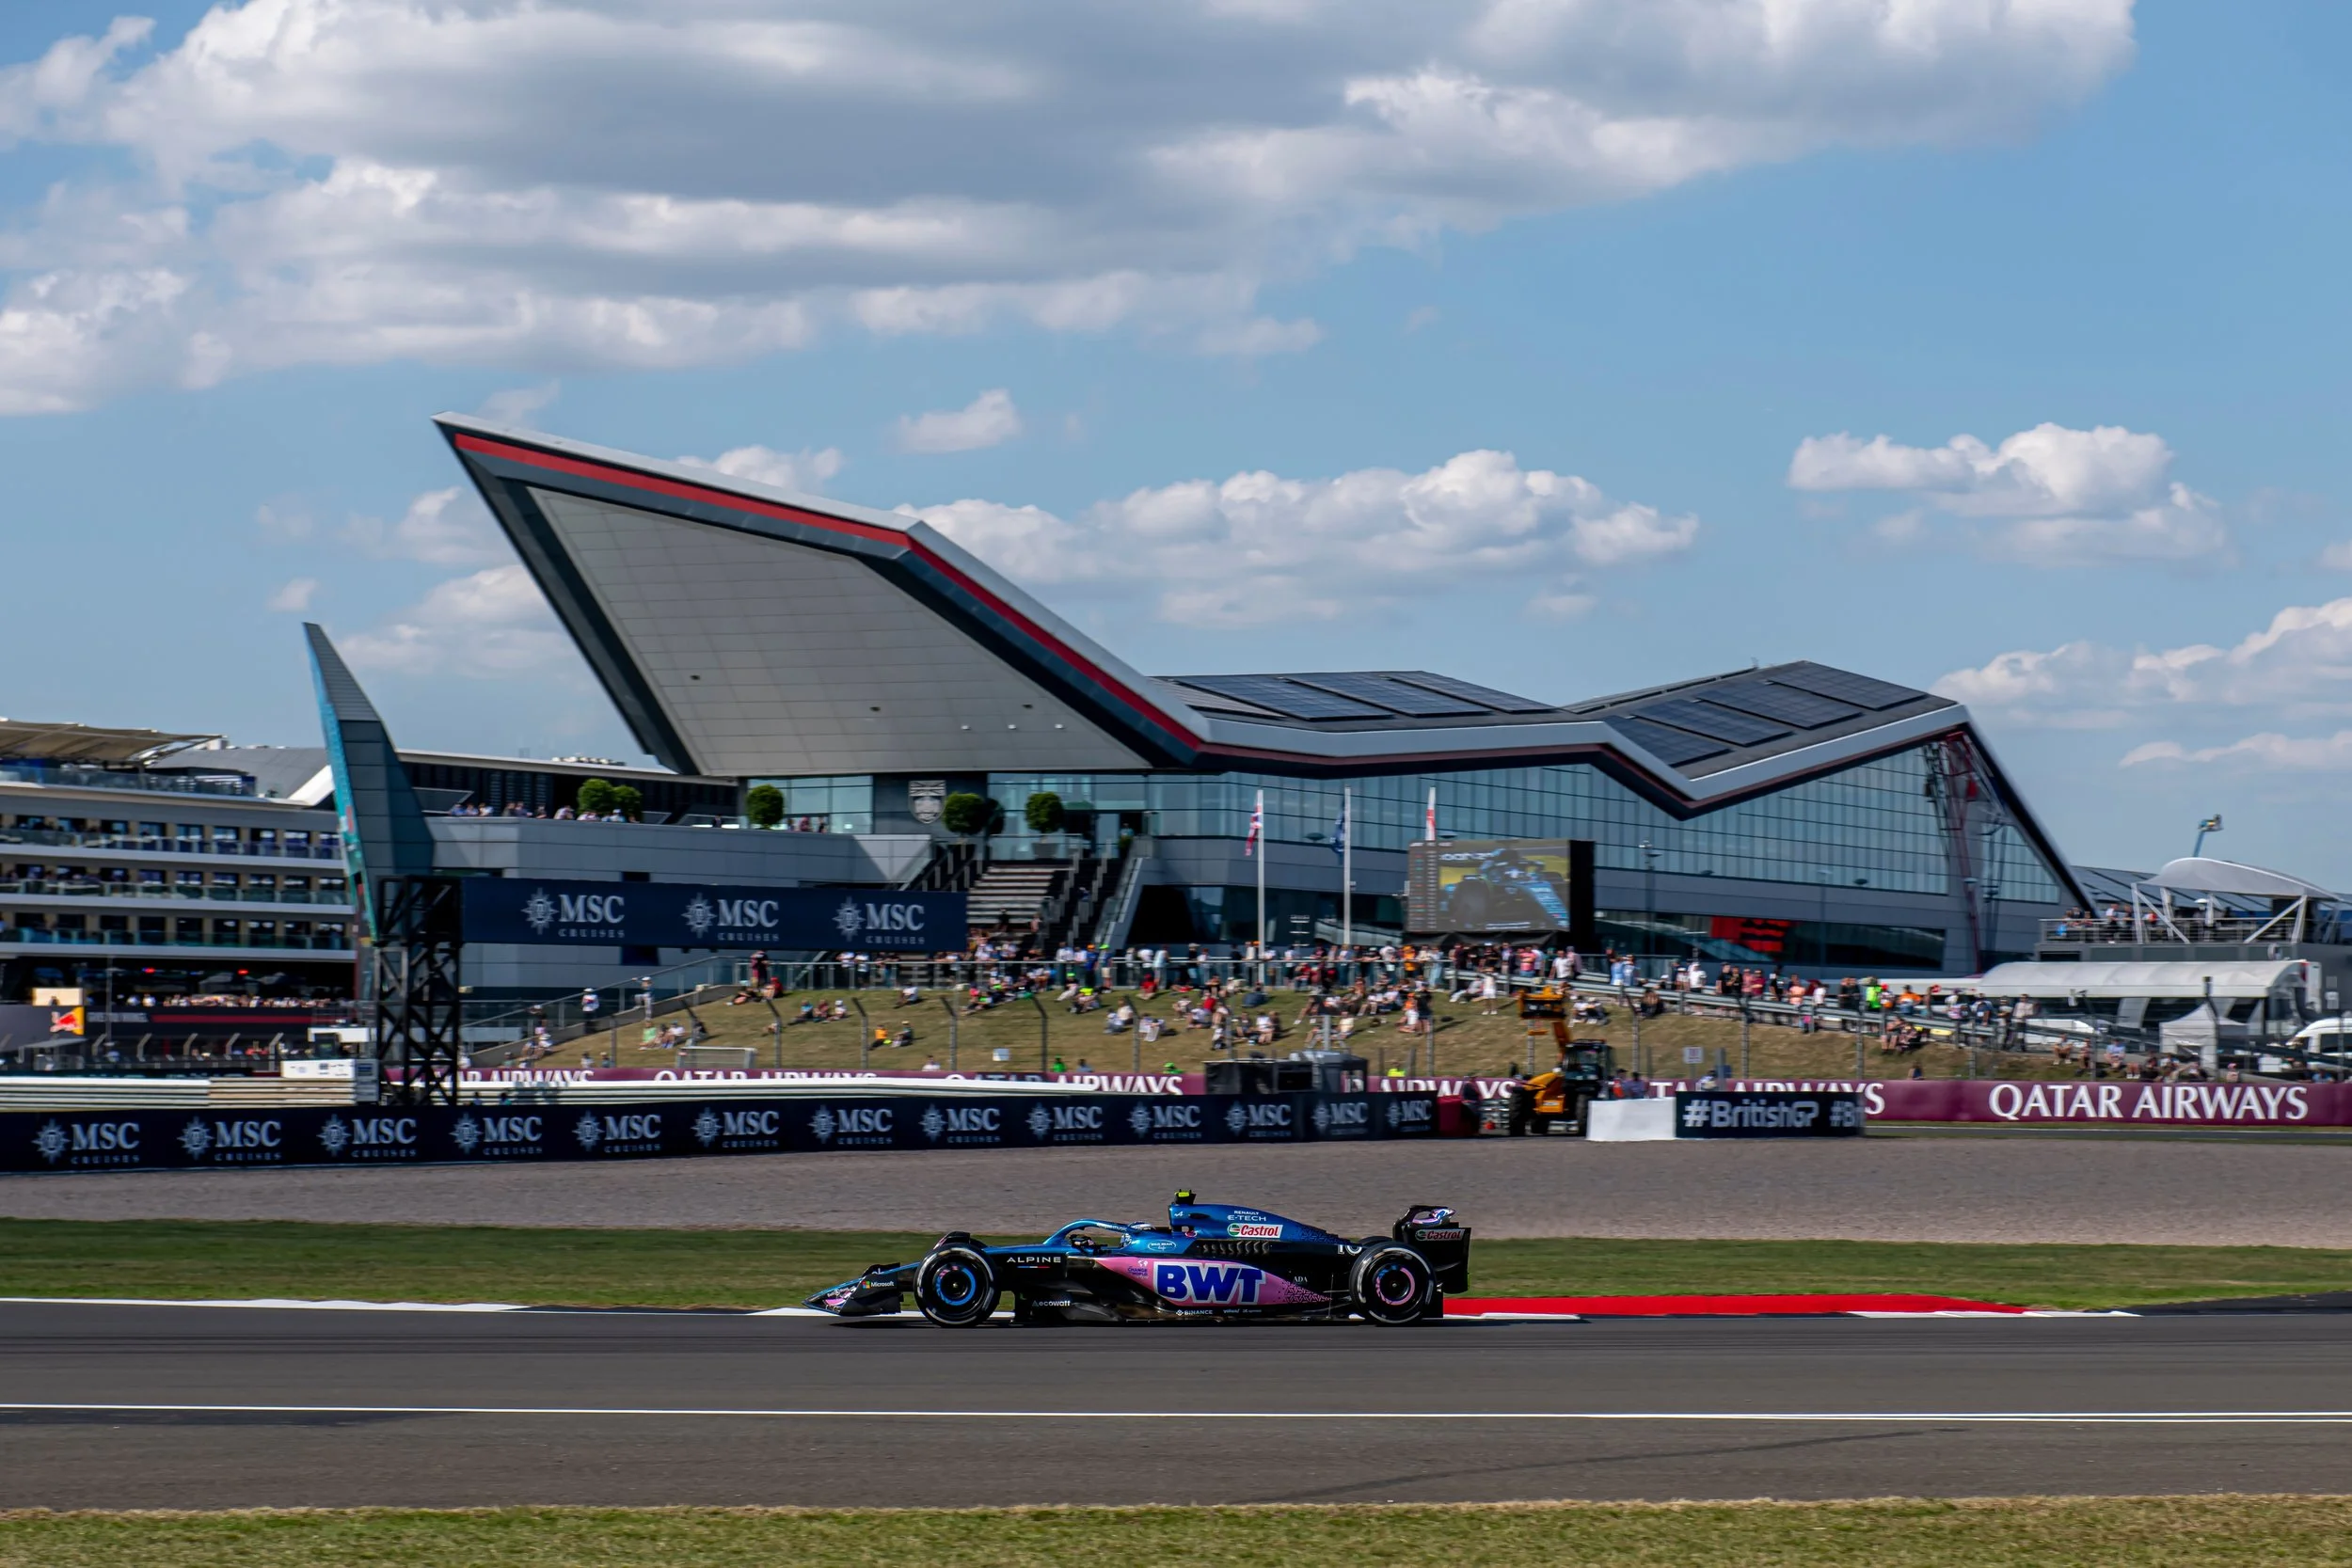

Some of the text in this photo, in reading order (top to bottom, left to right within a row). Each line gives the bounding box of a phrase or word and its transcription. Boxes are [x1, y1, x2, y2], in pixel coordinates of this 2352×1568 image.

[558, 895, 625, 923] MSC
[717, 899, 779, 927] MSC
[864, 904, 925, 930] MSC
[558, 927, 625, 938] CRUISES
[717, 932, 779, 942] CRUISES
[865, 936, 925, 944] CRUISES
[1682, 1099, 1820, 1128] #BritishGP
[1989, 1084, 2309, 1120] QATAR AIRWAYS
[723, 1111, 779, 1135] MSC
[836, 1109, 893, 1132] MSC
[946, 1108, 1000, 1131] MSC
[1053, 1106, 1103, 1130] MSC
[1152, 1105, 1201, 1128] MSC
[1248, 1104, 1291, 1126] MSC
[72, 1122, 139, 1150] MSC
[215, 1121, 281, 1148] MSC
[351, 1118, 417, 1145] MSC
[484, 1117, 542, 1142] MSC
[603, 1115, 661, 1140] MSC
[1240, 1224, 1279, 1237] Castrol
[1427, 1230, 1462, 1240] Castrol
[1155, 1263, 1263, 1304] BWT
